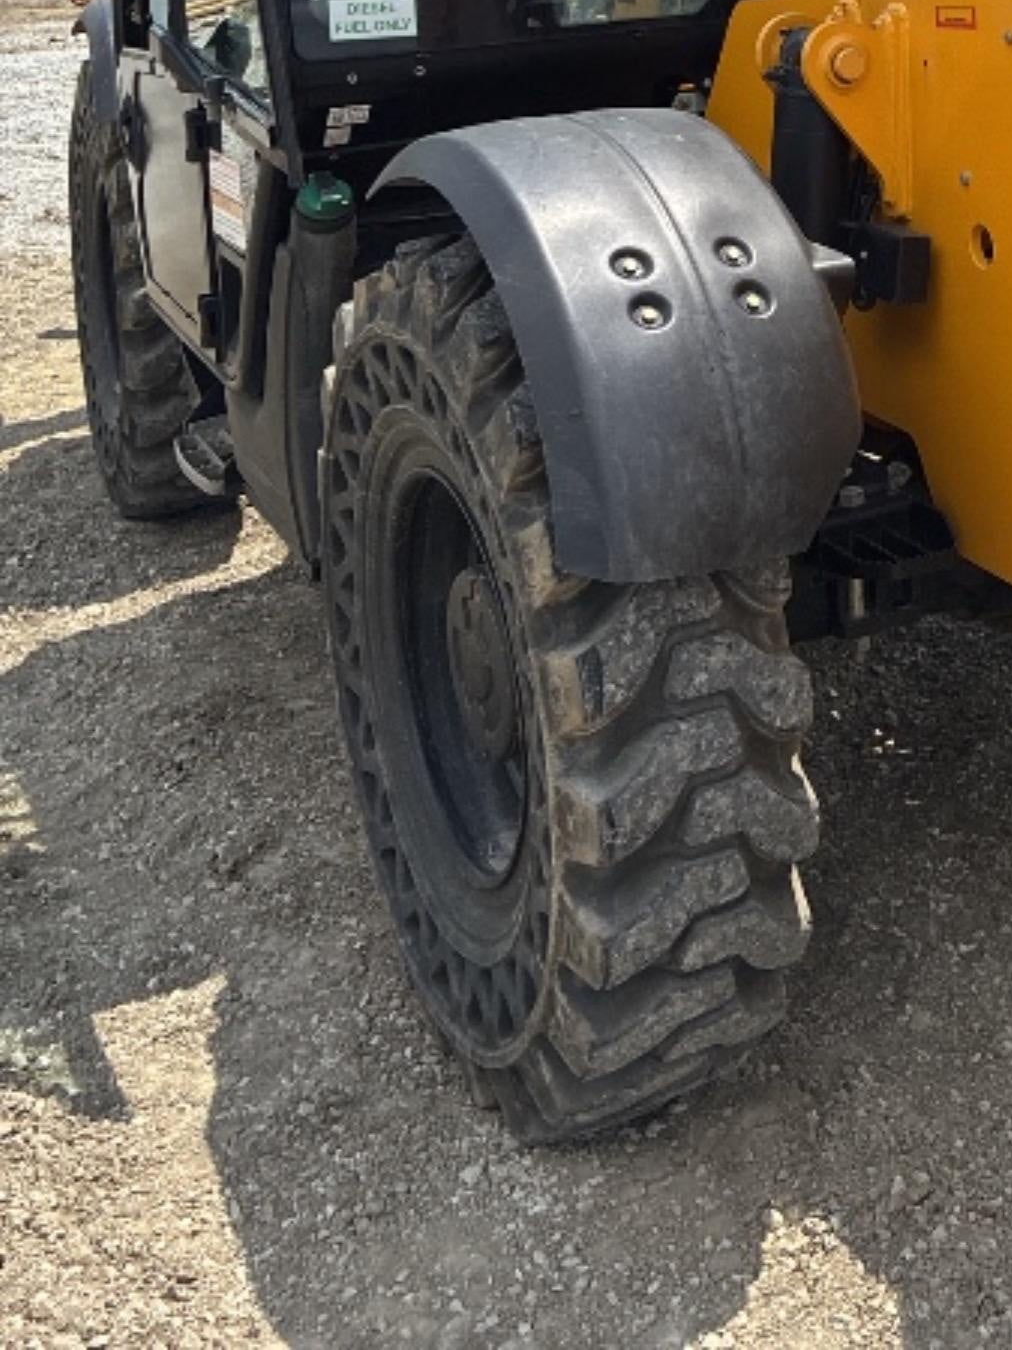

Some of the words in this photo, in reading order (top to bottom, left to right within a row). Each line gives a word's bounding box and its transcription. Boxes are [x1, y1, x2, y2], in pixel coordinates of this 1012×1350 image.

[346, 1, 397, 16] DIESEL
[334, 19, 371, 35] FUEL
[373, 17, 412, 34] ONLY
